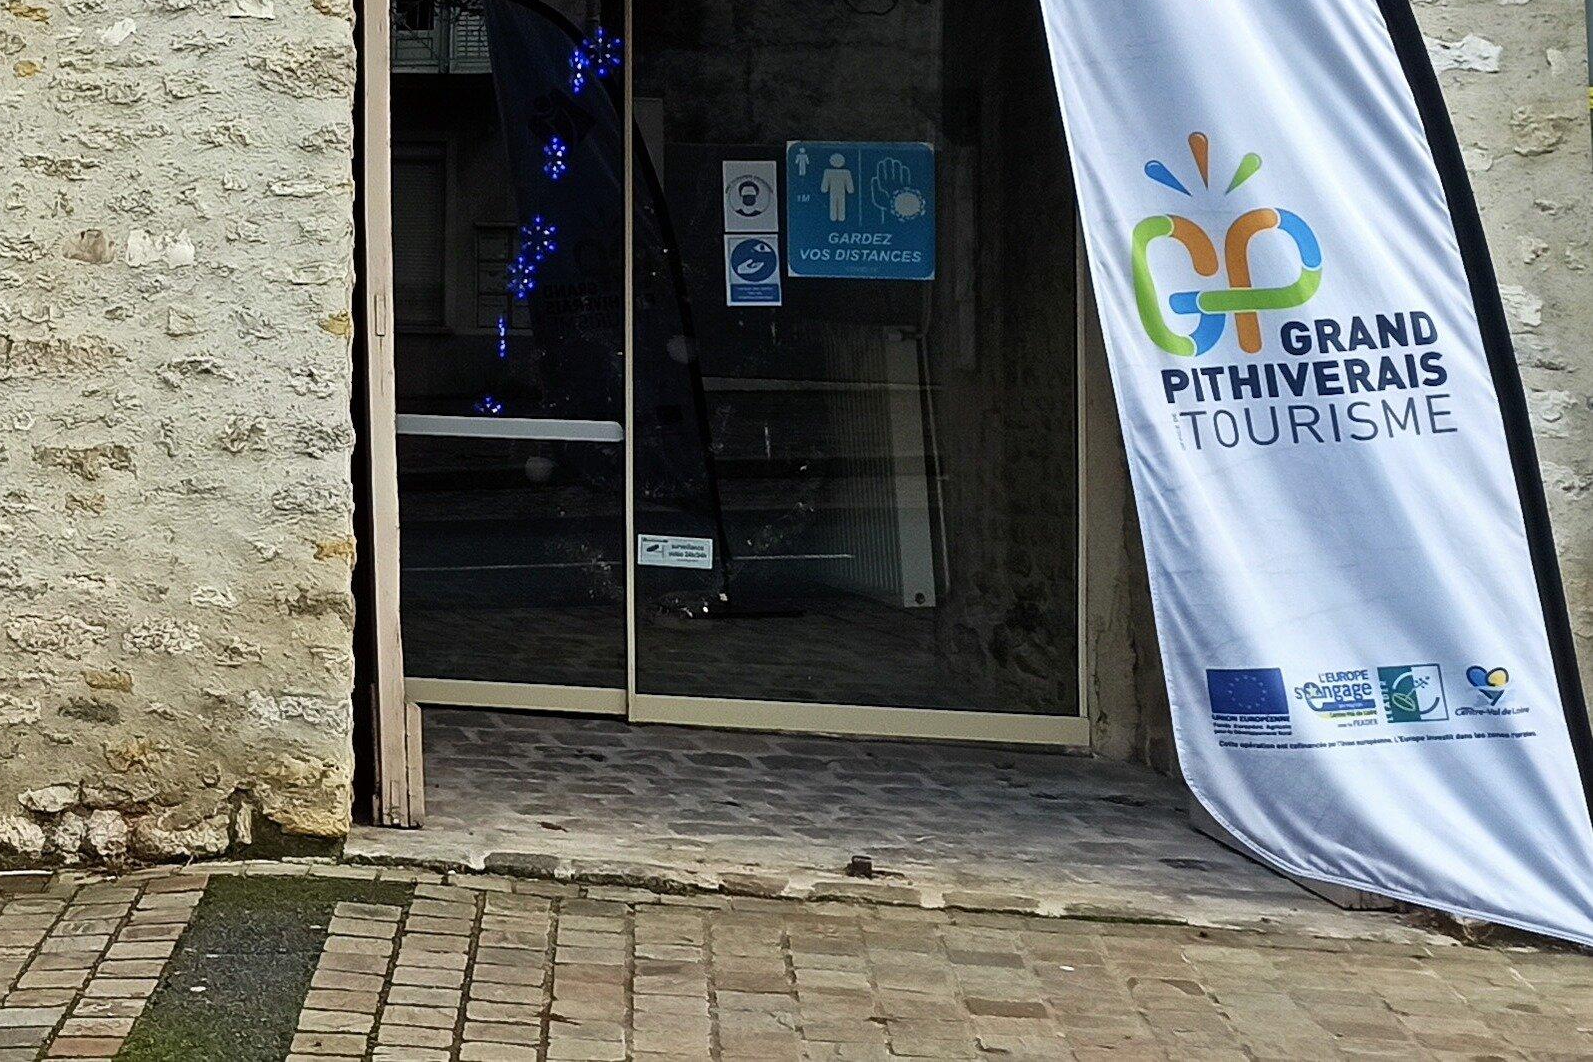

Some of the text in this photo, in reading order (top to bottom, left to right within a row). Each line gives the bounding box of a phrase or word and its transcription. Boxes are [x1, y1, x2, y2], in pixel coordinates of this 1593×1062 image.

[828, 231, 893, 245] GARDEZ
[799, 248, 923, 263] VOS DISTANCES
[1279, 310, 1439, 357] GRAND
[1160, 351, 1448, 404] PITHIVERAIS
[1179, 393, 1458, 451] TOURISME
[1318, 669, 1369, 684] L'EUROPE
[1501, 708, 1512, 716] de
[1512, 706, 1530, 715] Loire
